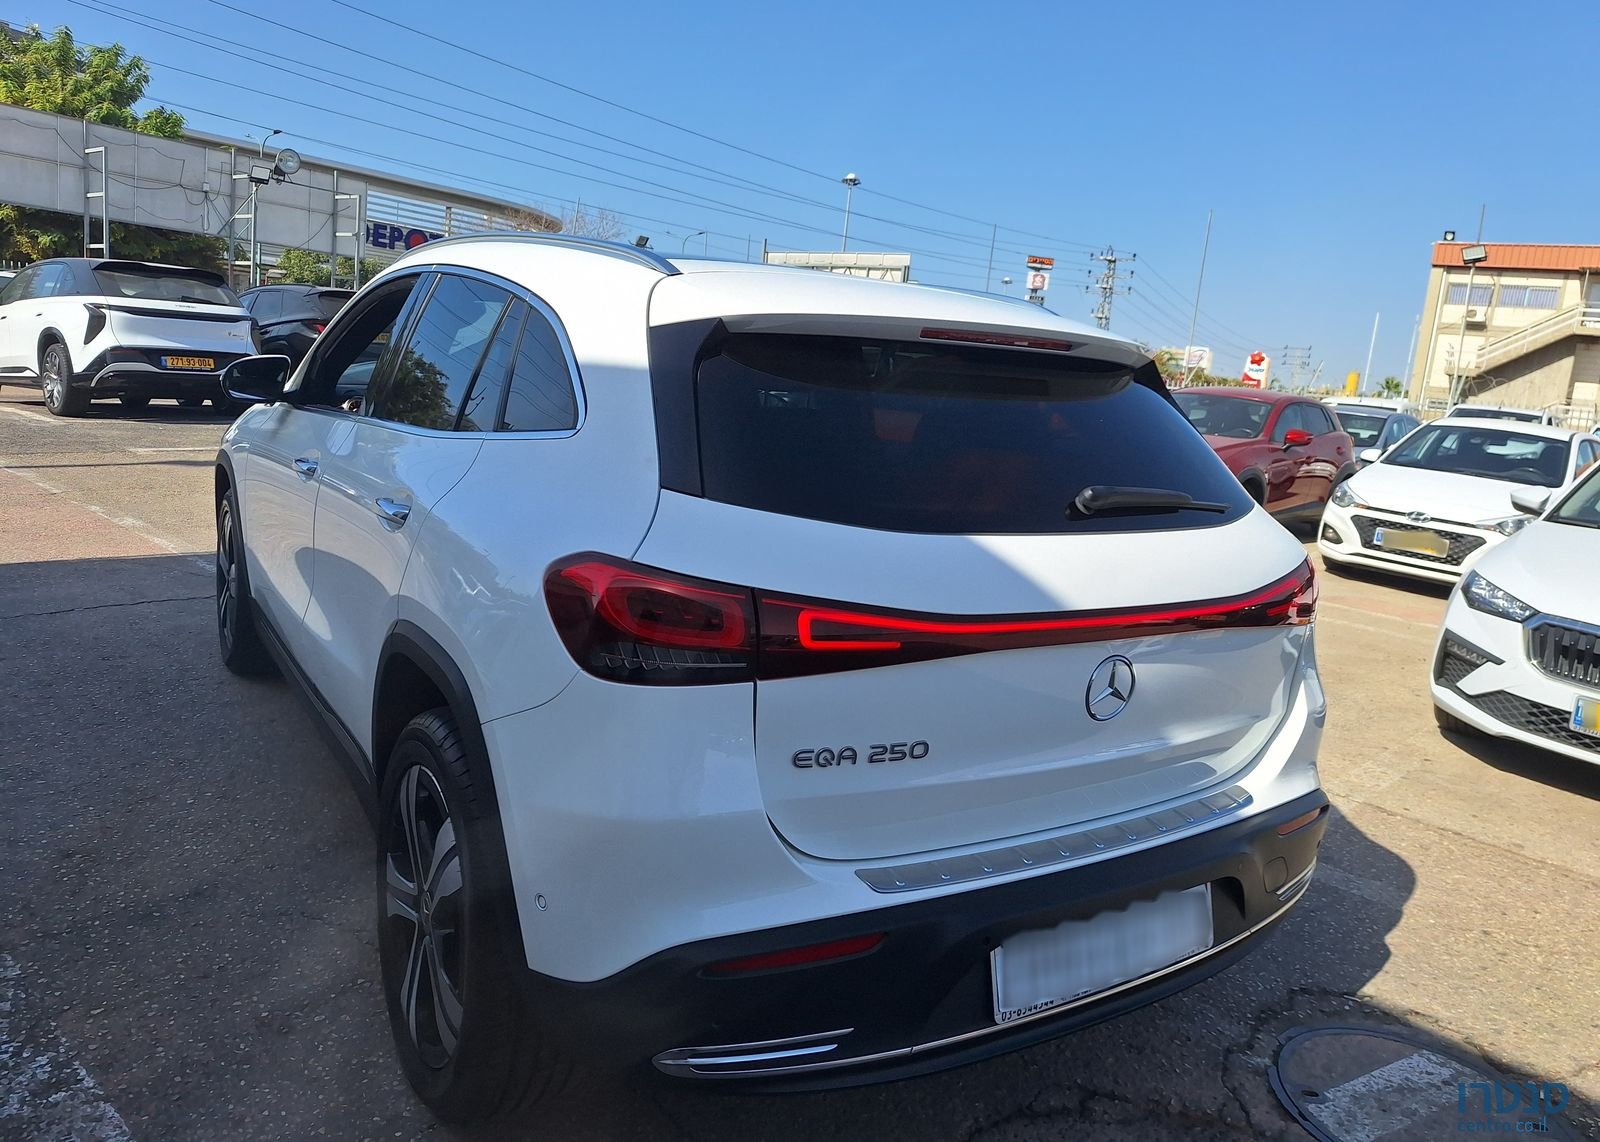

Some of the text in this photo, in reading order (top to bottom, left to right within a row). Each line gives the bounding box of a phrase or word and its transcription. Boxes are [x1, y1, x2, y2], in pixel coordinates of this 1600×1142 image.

[366, 223, 445, 250] EPO
[792, 740, 930, 768] EQA 250
